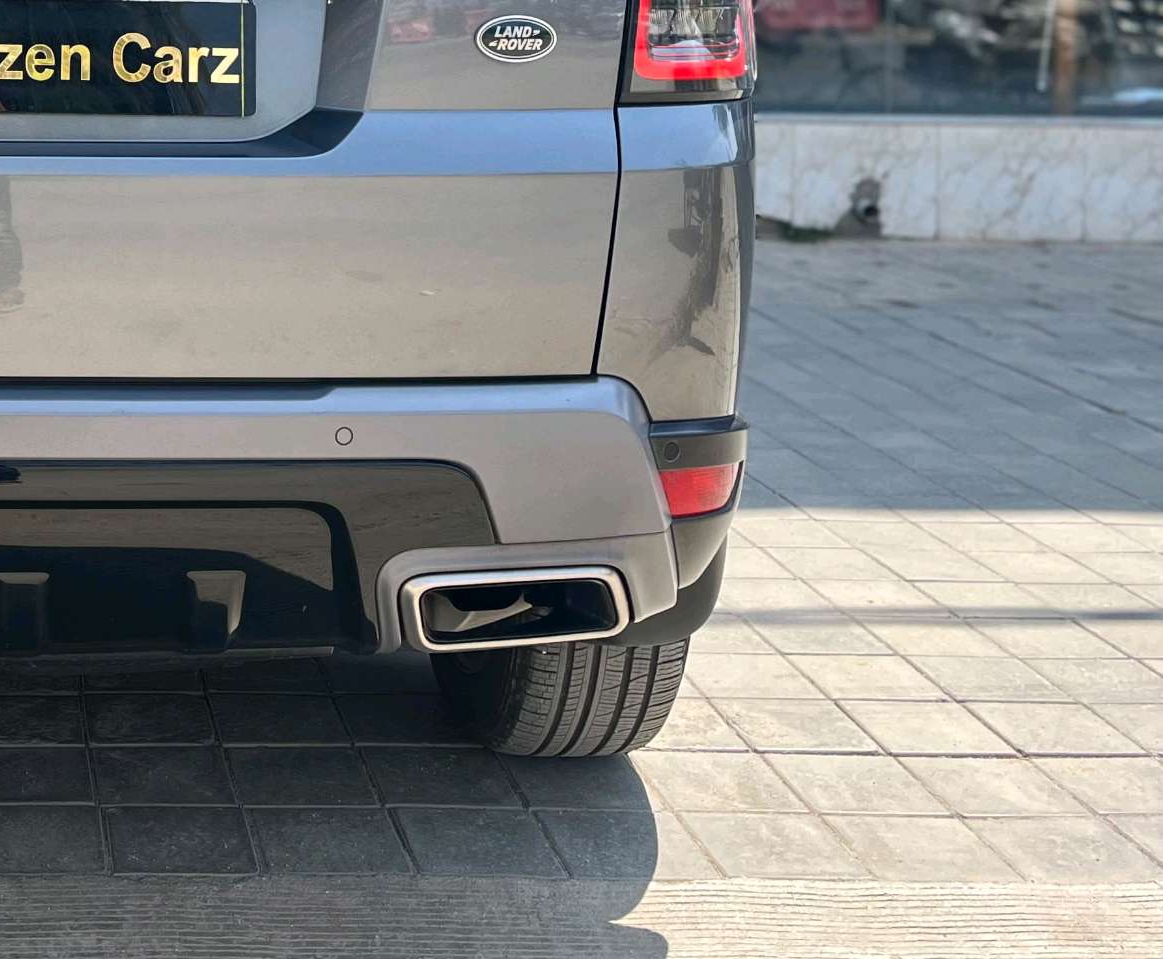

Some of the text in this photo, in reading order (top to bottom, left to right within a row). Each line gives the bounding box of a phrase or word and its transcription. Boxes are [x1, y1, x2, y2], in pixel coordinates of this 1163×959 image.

[494, 25, 533, 38] LAND
[496, 38, 543, 51] ROVER
[112, 31, 241, 84] Carz
